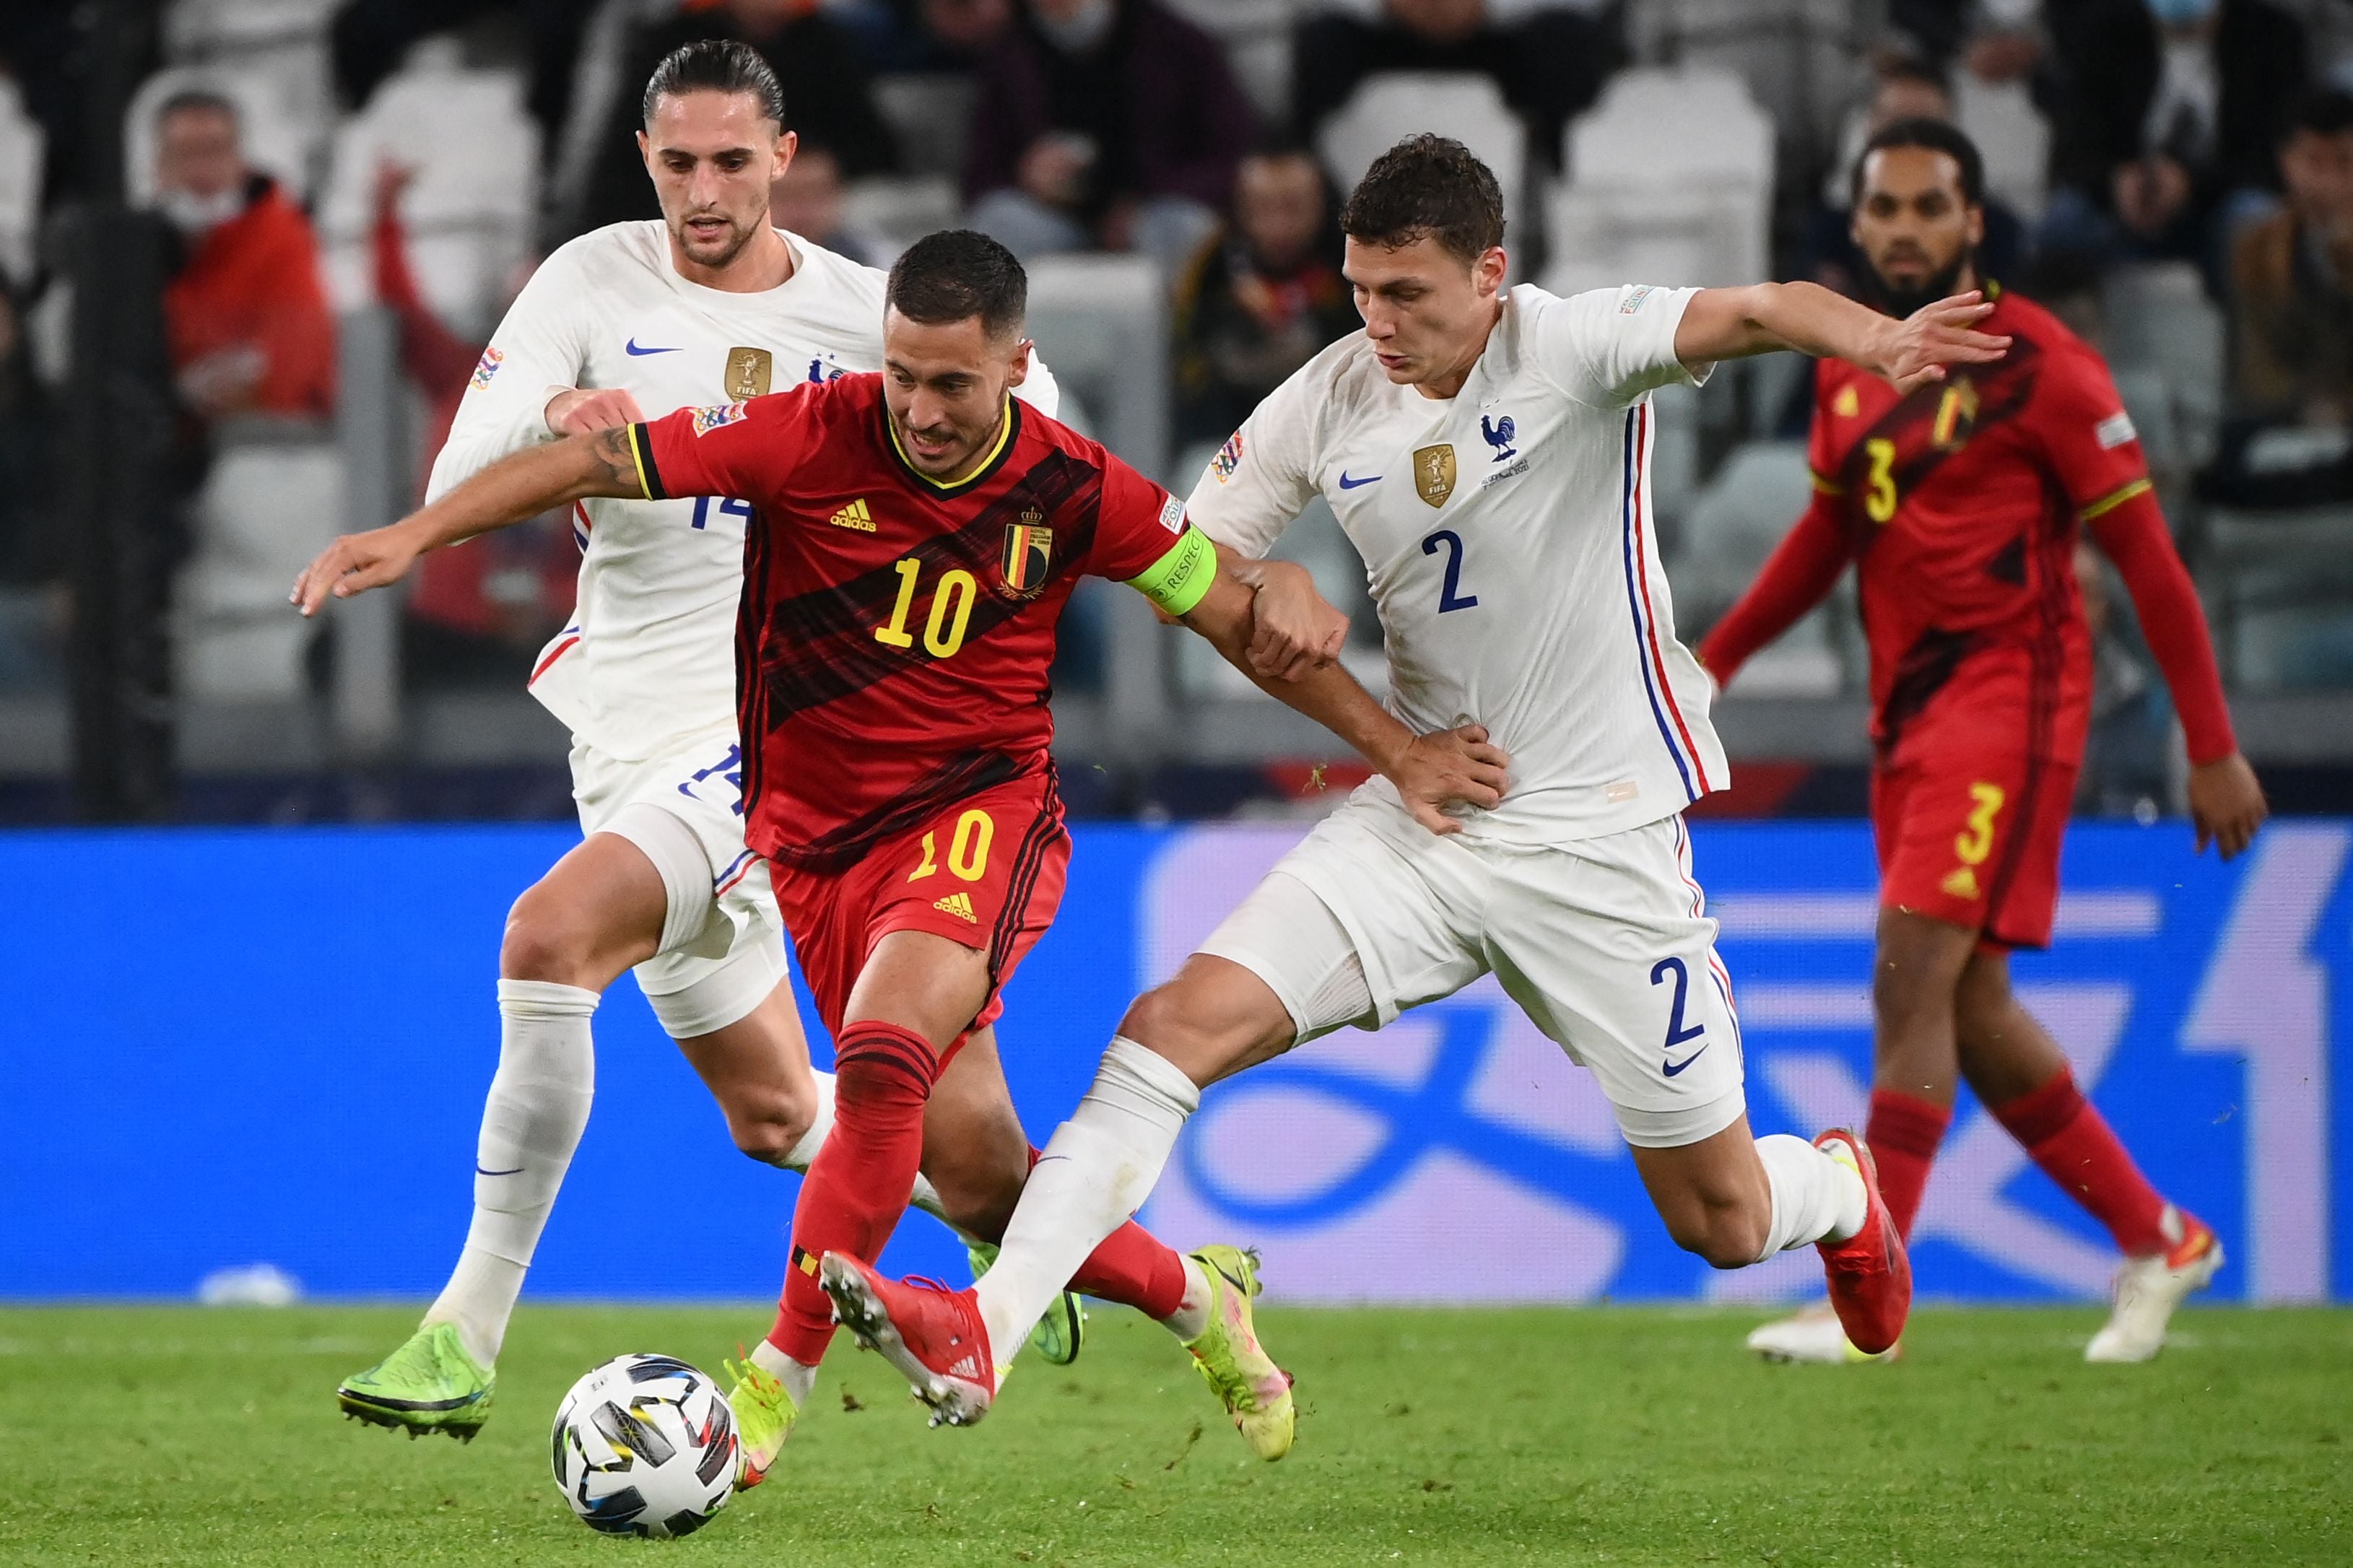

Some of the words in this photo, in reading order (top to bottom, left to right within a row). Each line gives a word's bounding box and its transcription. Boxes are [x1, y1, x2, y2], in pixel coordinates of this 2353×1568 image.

[736, 386, 757, 396] FIFA
[1166, 498, 1180, 528] FOU
[1428, 484, 1446, 495] FIFA
[1866, 438, 1897, 523] 3
[830, 515, 877, 533] adidas
[1167, 531, 1201, 589] RESPECT
[1422, 530, 1478, 614] 2
[874, 557, 977, 658] 10
[907, 809, 994, 884] 10
[1955, 782, 2005, 865] 3
[933, 902, 978, 924] adidas
[1650, 957, 1705, 1048] 2
